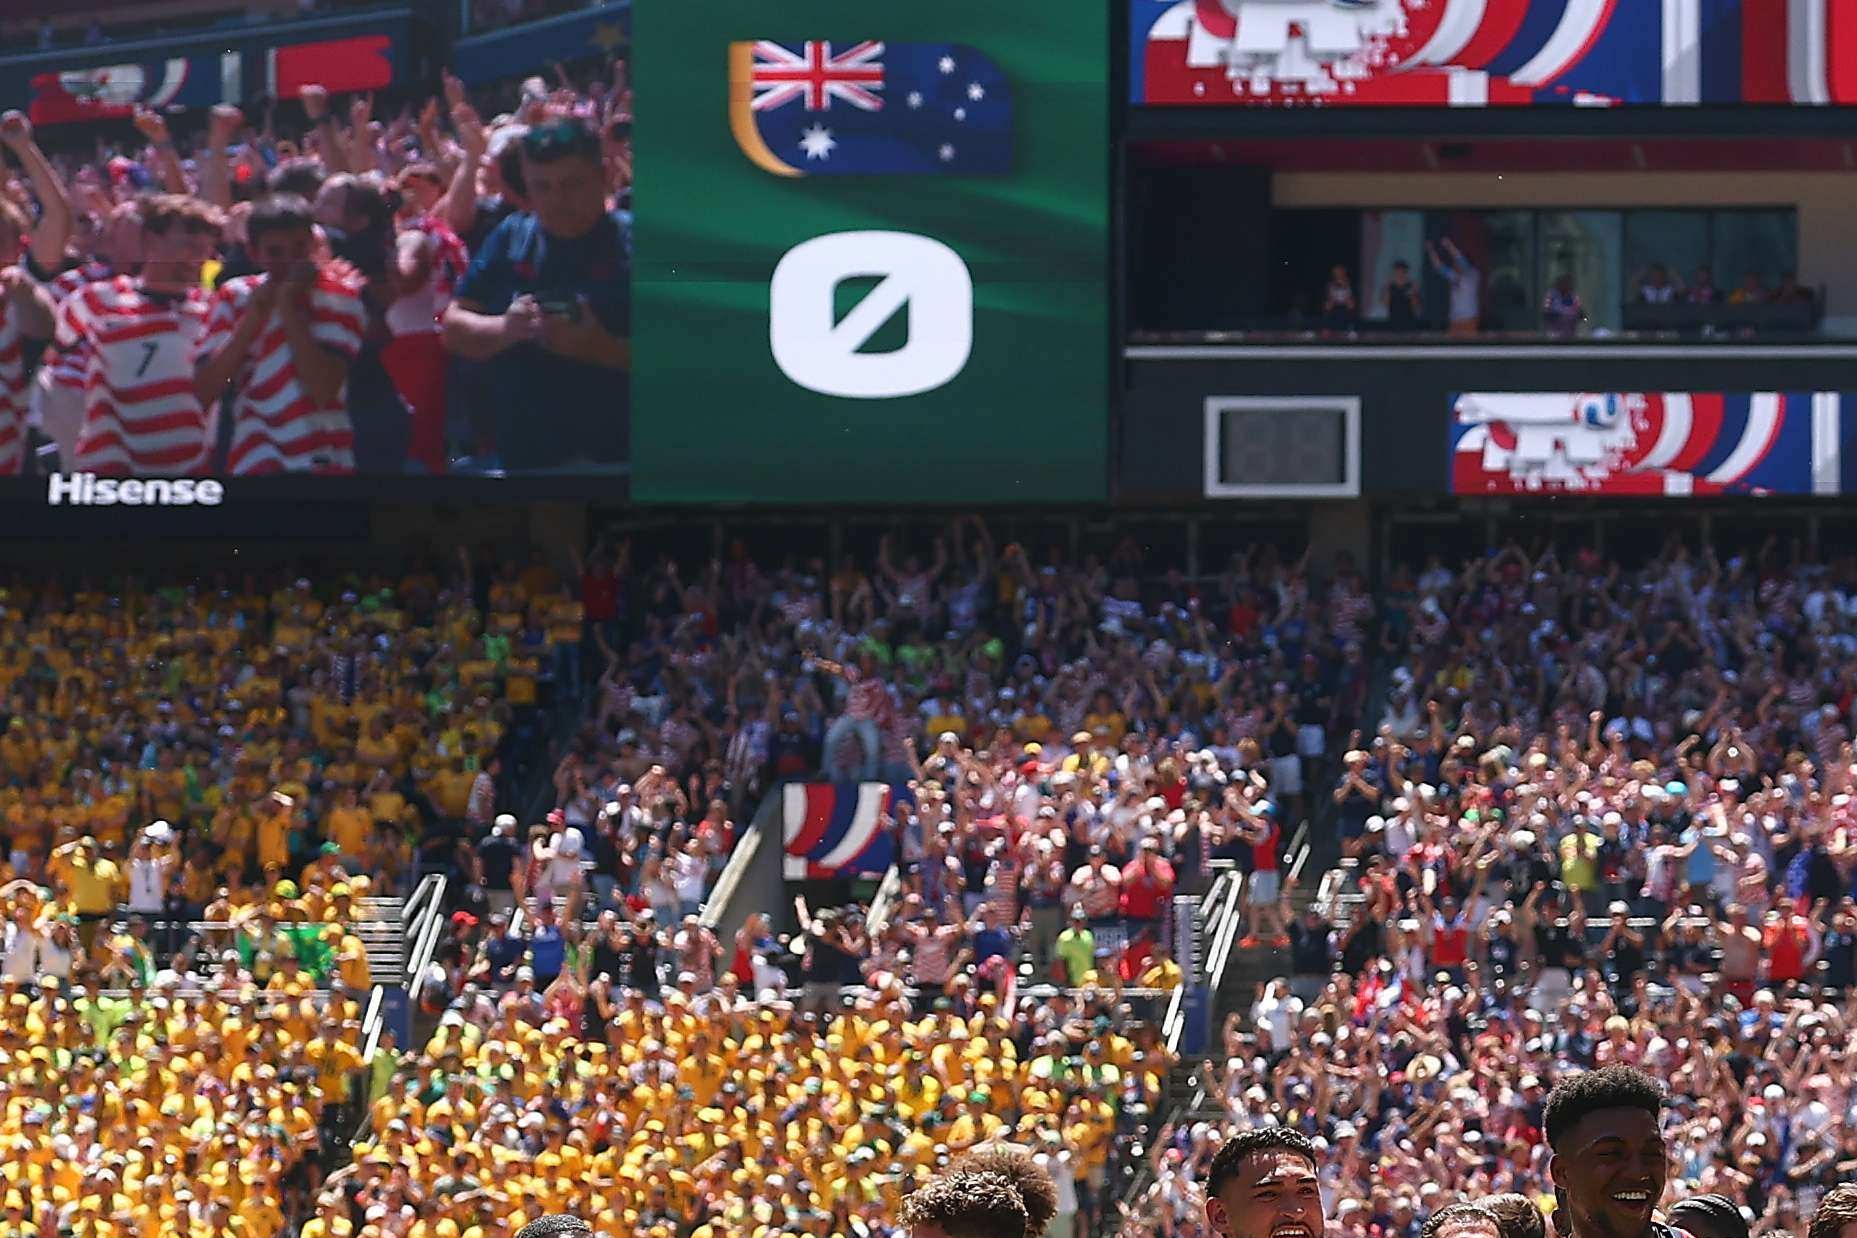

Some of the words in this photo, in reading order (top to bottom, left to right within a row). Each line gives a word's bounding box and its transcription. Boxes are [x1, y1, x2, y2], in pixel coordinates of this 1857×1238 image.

[769, 230, 973, 398] 0
[136, 341, 159, 377] 7
[48, 472, 224, 505] Hisense
